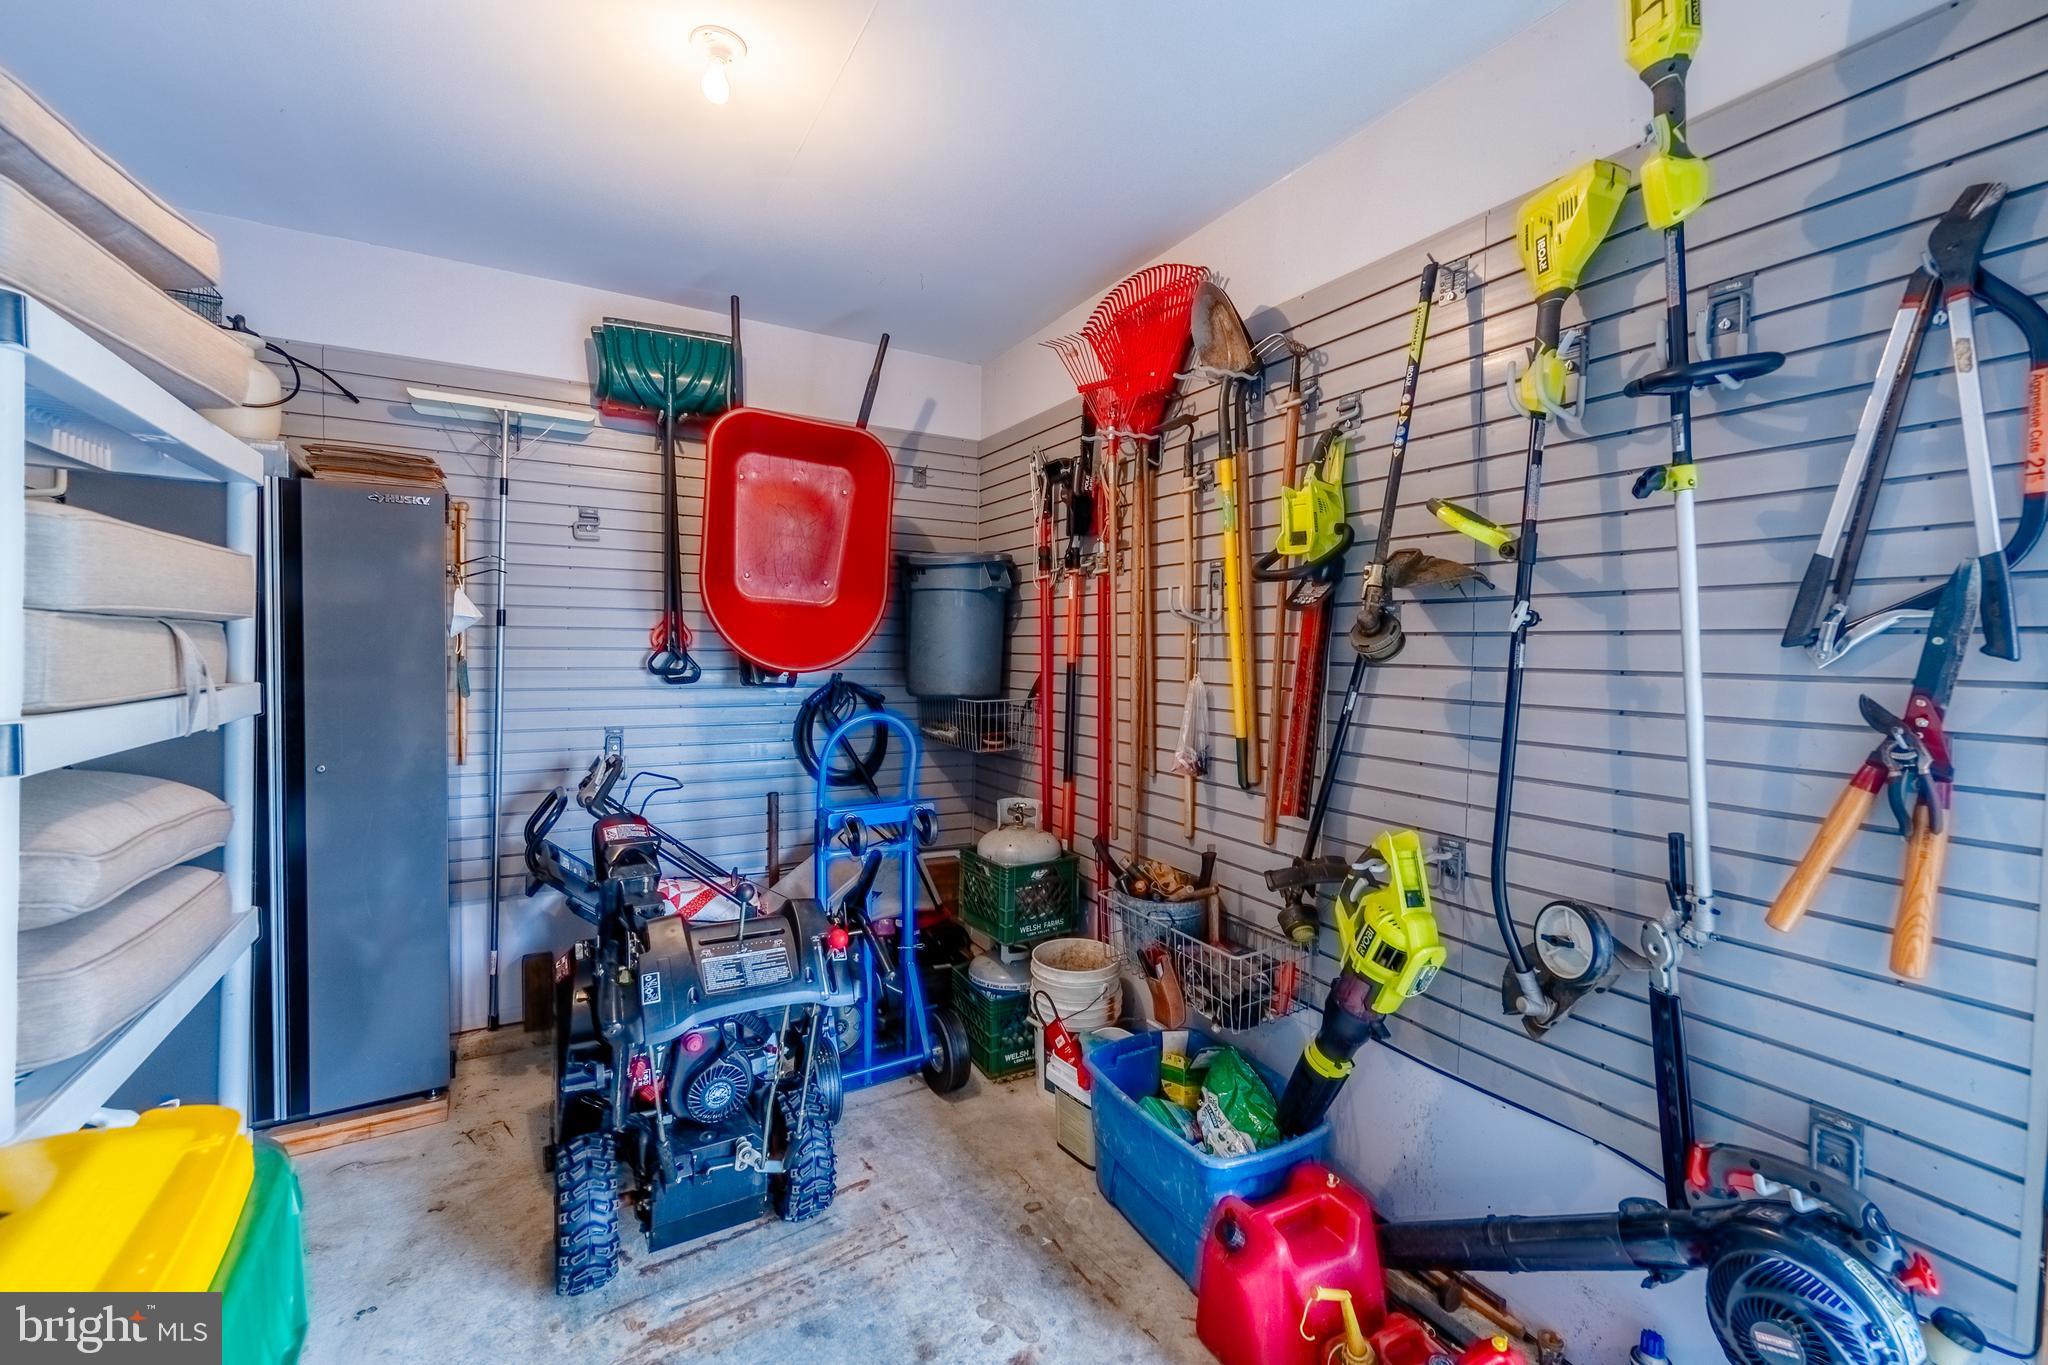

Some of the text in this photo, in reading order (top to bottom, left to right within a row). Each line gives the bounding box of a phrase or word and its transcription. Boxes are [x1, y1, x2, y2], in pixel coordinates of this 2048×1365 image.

[1537, 236, 1548, 272] RYOBI
[1405, 365, 1414, 386] RYOBI
[2030, 430, 2043, 453] Cuts
[384, 494, 430, 505] HUSKY
[1020, 918, 1065, 934] WELSH FARMS
[1357, 927, 1375, 956] RYOBI
[1004, 1049, 1029, 1062] WELSH
